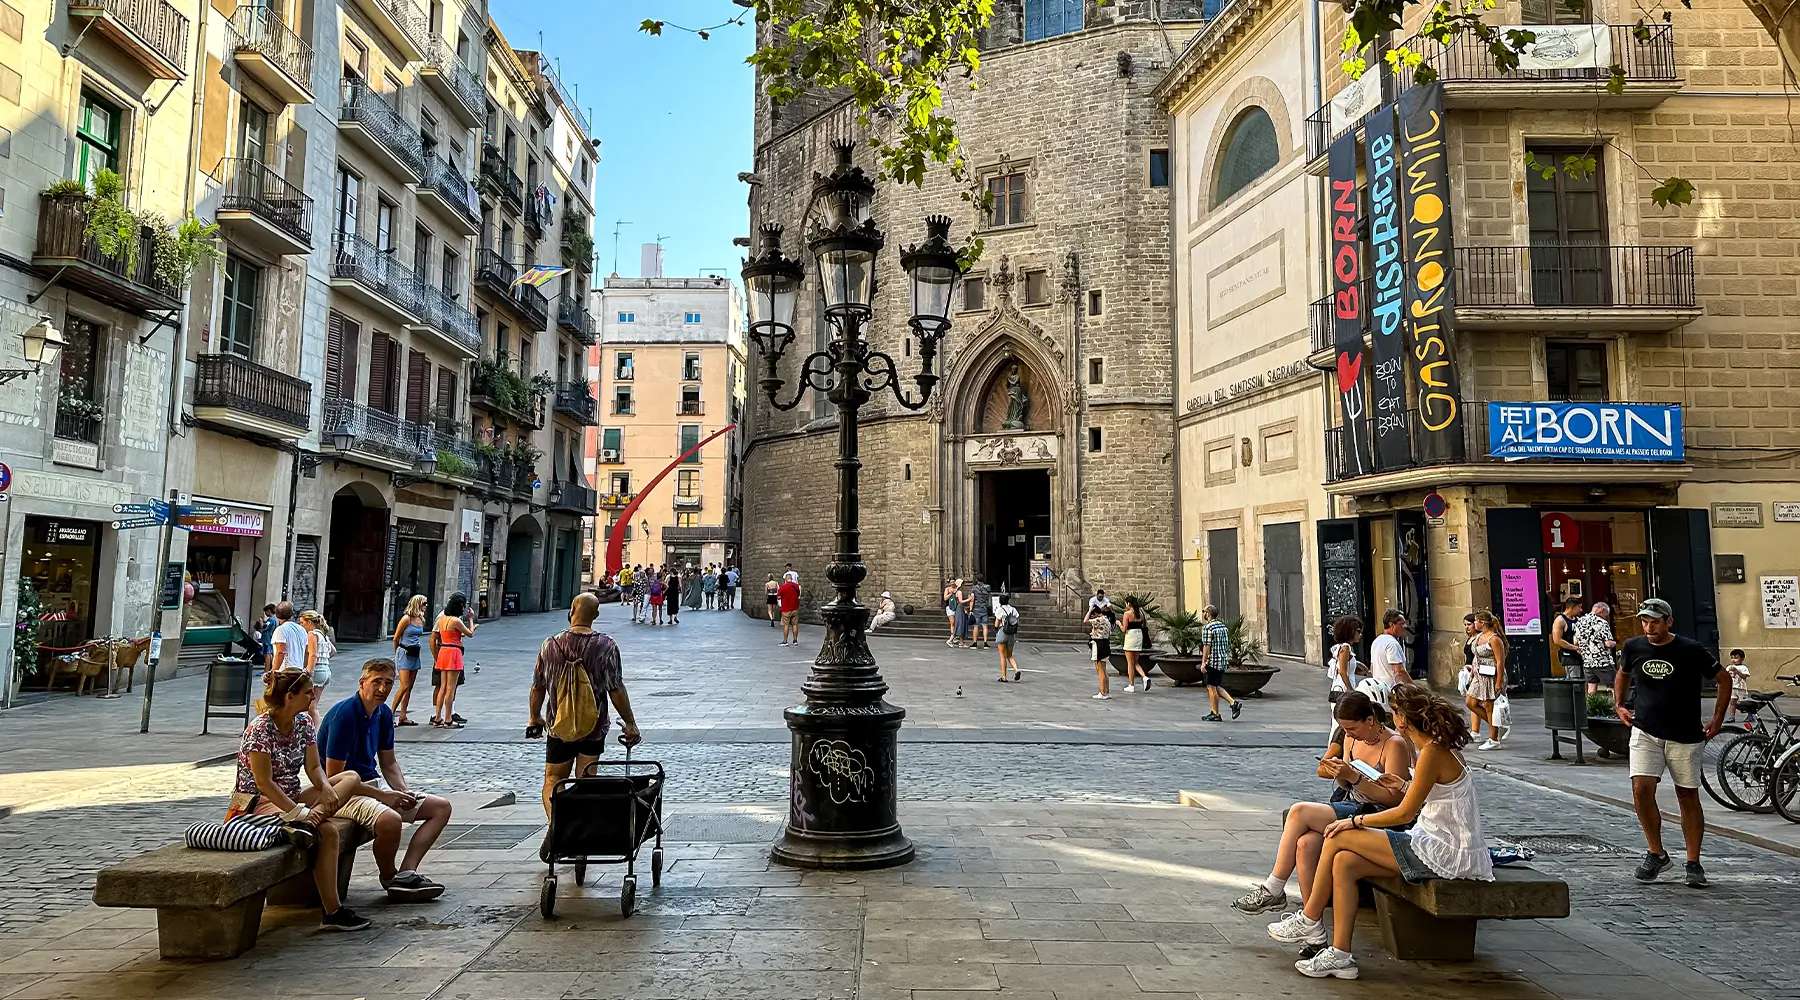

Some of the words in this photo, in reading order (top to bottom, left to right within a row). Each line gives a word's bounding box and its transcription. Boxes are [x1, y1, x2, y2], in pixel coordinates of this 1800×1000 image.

[1333, 179, 1360, 319] BORN
[1380, 375, 1396, 397] TO
[1186, 393, 1213, 411] CAPELLA
[1214, 386, 1228, 402] DEL
[1500, 406, 1531, 424] FET
[1501, 425, 1533, 443] AL
[1536, 407, 1673, 446] BORN
[1559, 446, 1568, 454] CAP
[1602, 447, 1615, 455] CADA
[1632, 448, 1650, 456] PASSEIG
[234, 512, 261, 528] minyó
[1551, 519, 1565, 548] i
